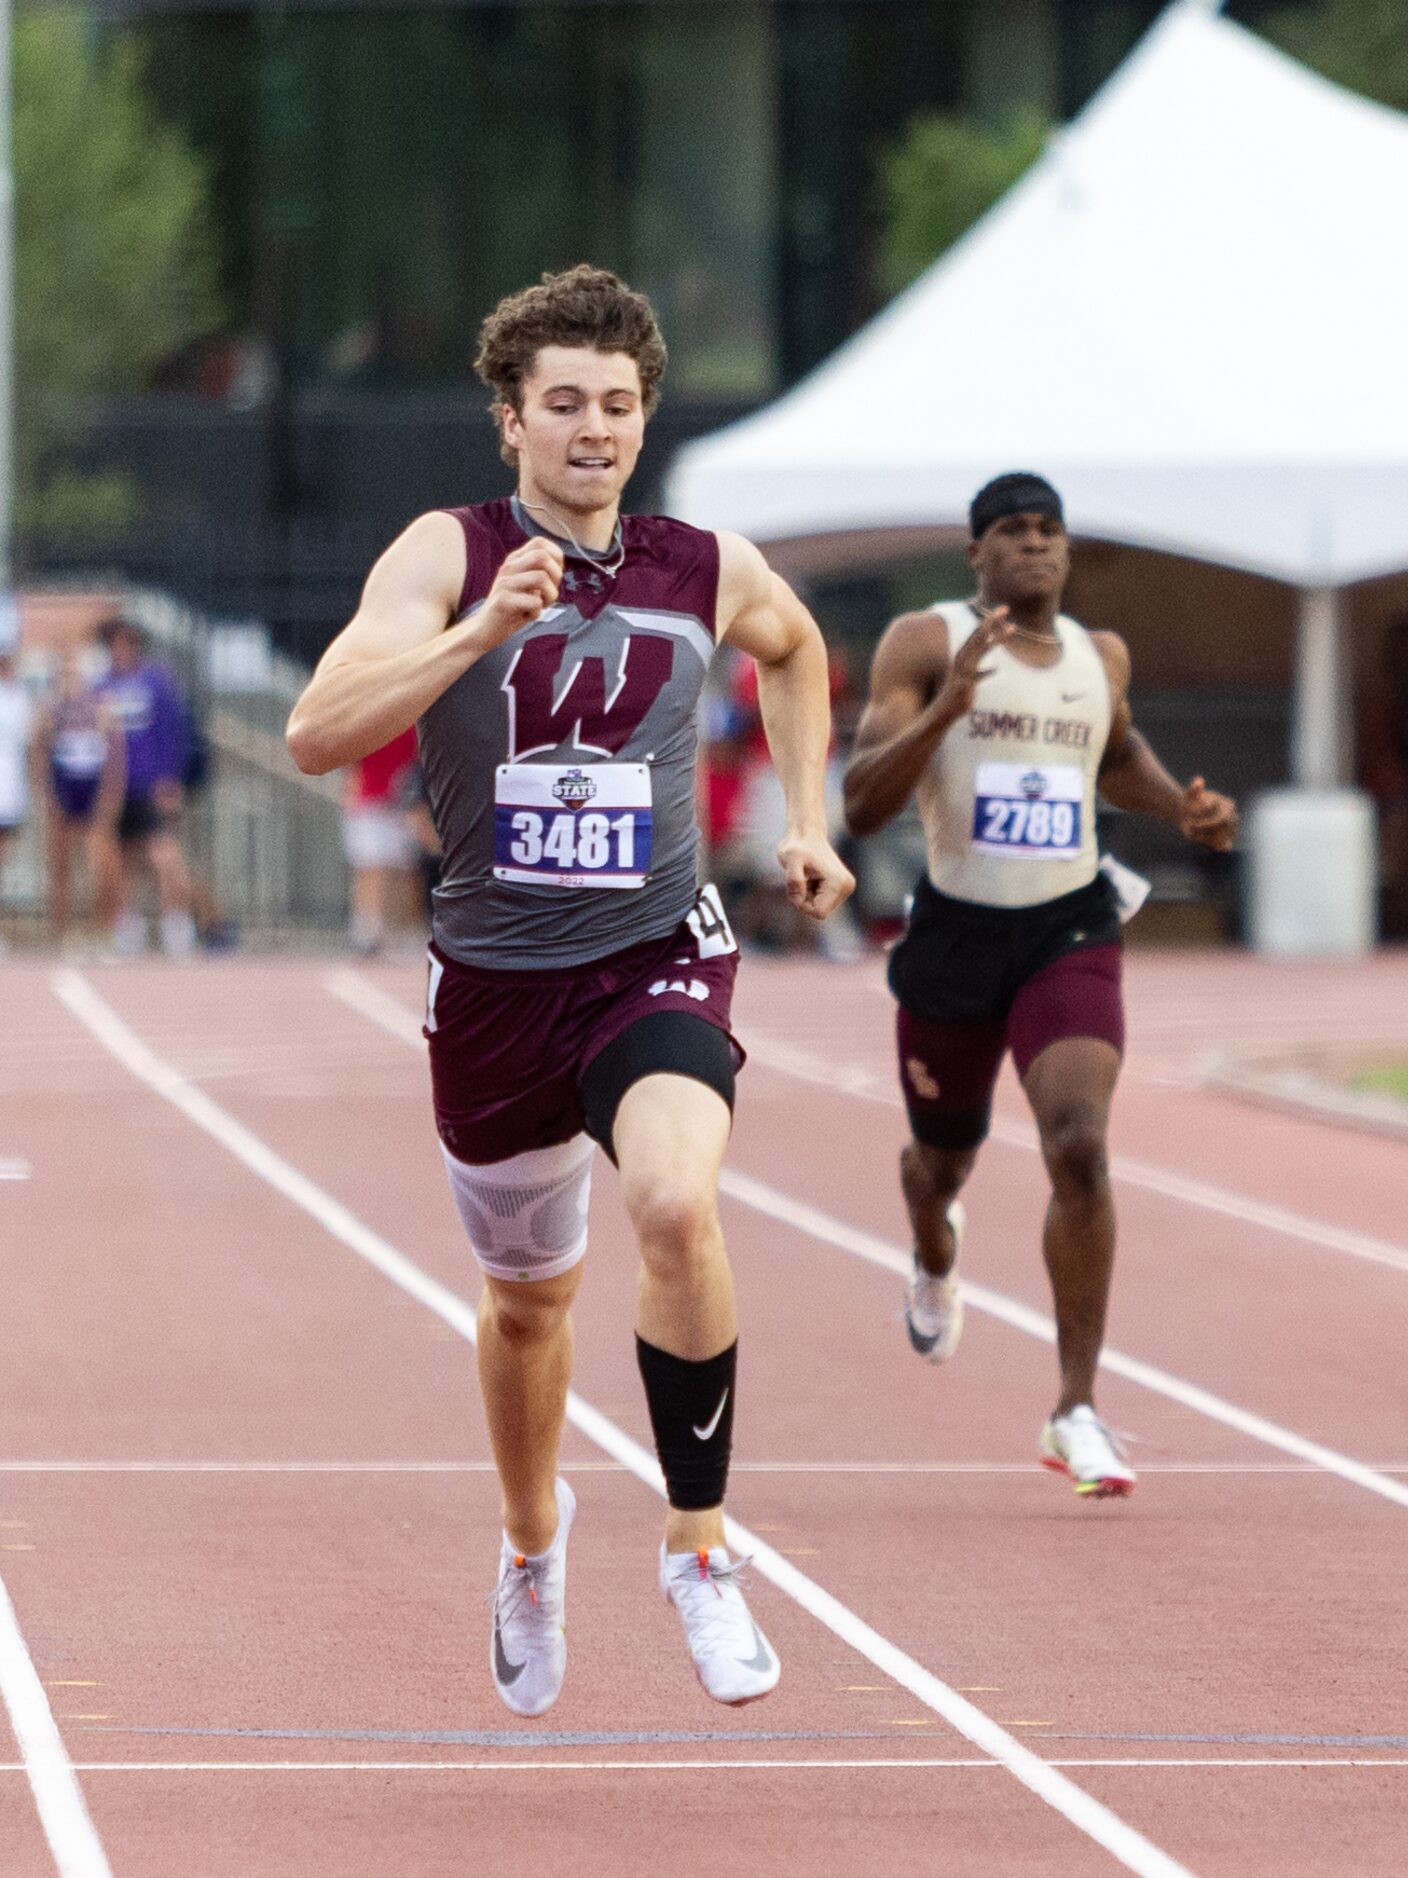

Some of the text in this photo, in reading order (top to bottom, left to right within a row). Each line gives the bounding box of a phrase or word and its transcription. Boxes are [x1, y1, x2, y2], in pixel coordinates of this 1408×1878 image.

[501, 633, 675, 765] W
[969, 710, 1092, 747] SUMMER CREEK
[551, 783, 597, 797] STATE
[510, 811, 636, 869] 3481
[983, 801, 1073, 847] 2789
[558, 875, 585, 886] 2022
